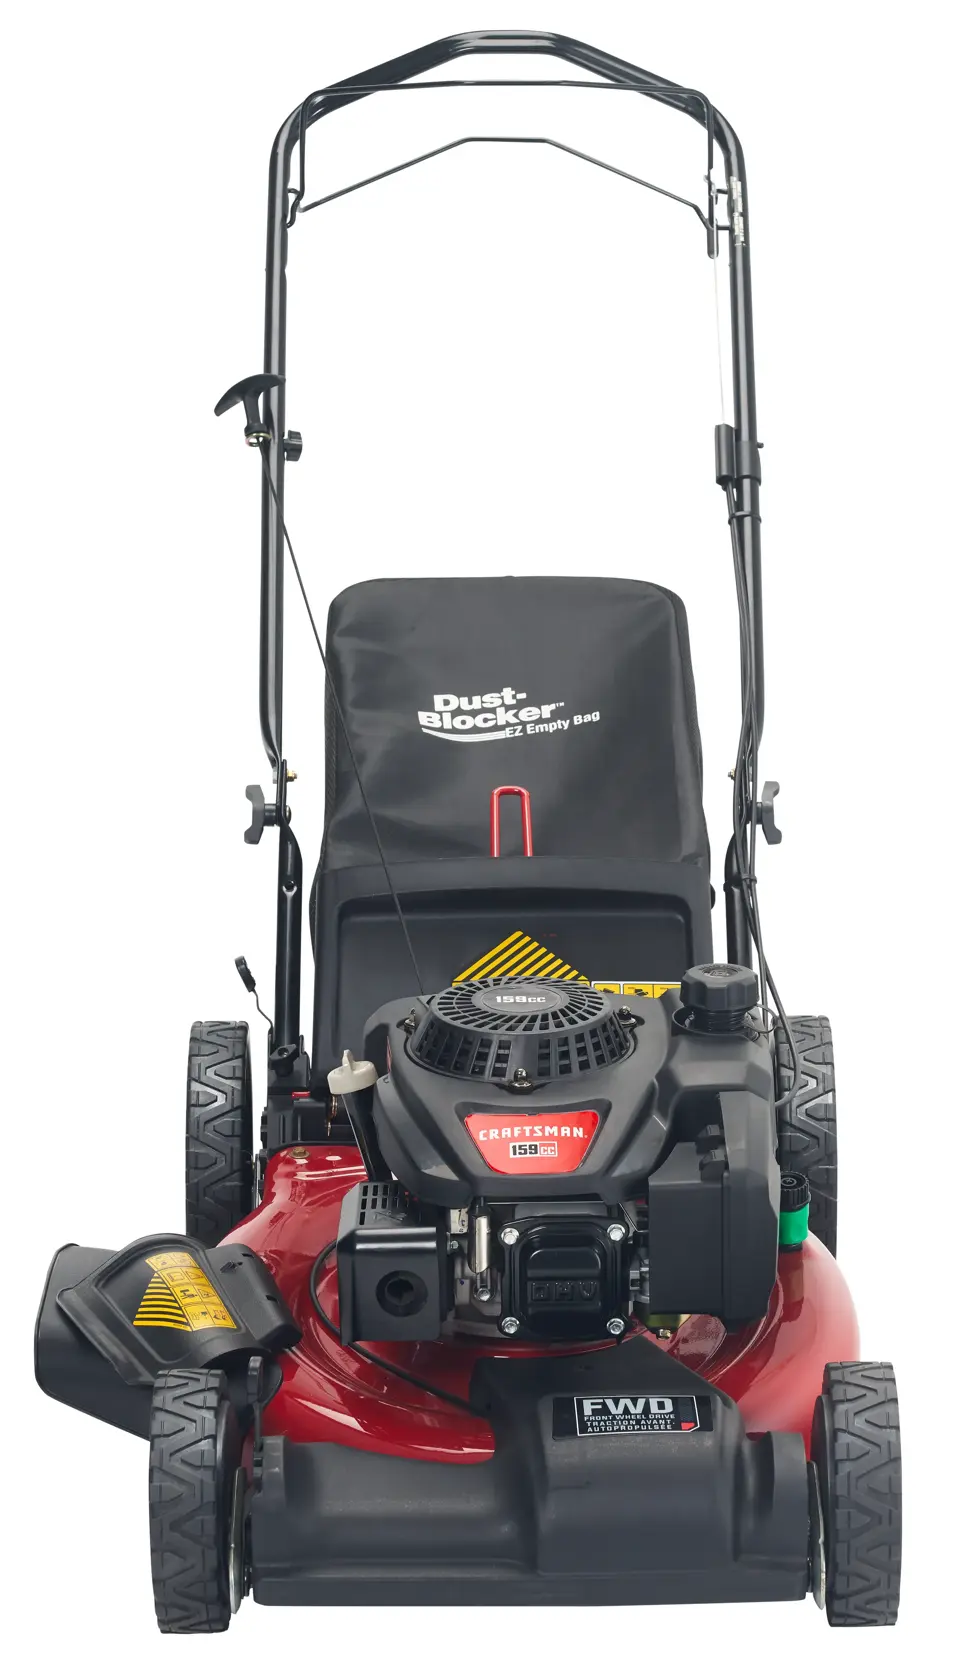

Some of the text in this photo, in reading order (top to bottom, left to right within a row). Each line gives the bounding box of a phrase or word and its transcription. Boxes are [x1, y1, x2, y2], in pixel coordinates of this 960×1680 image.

[433, 687, 527, 712] Dust-
[505, 711, 600, 738] EZ Empty Bag
[582, 1397, 674, 1416] FWD
